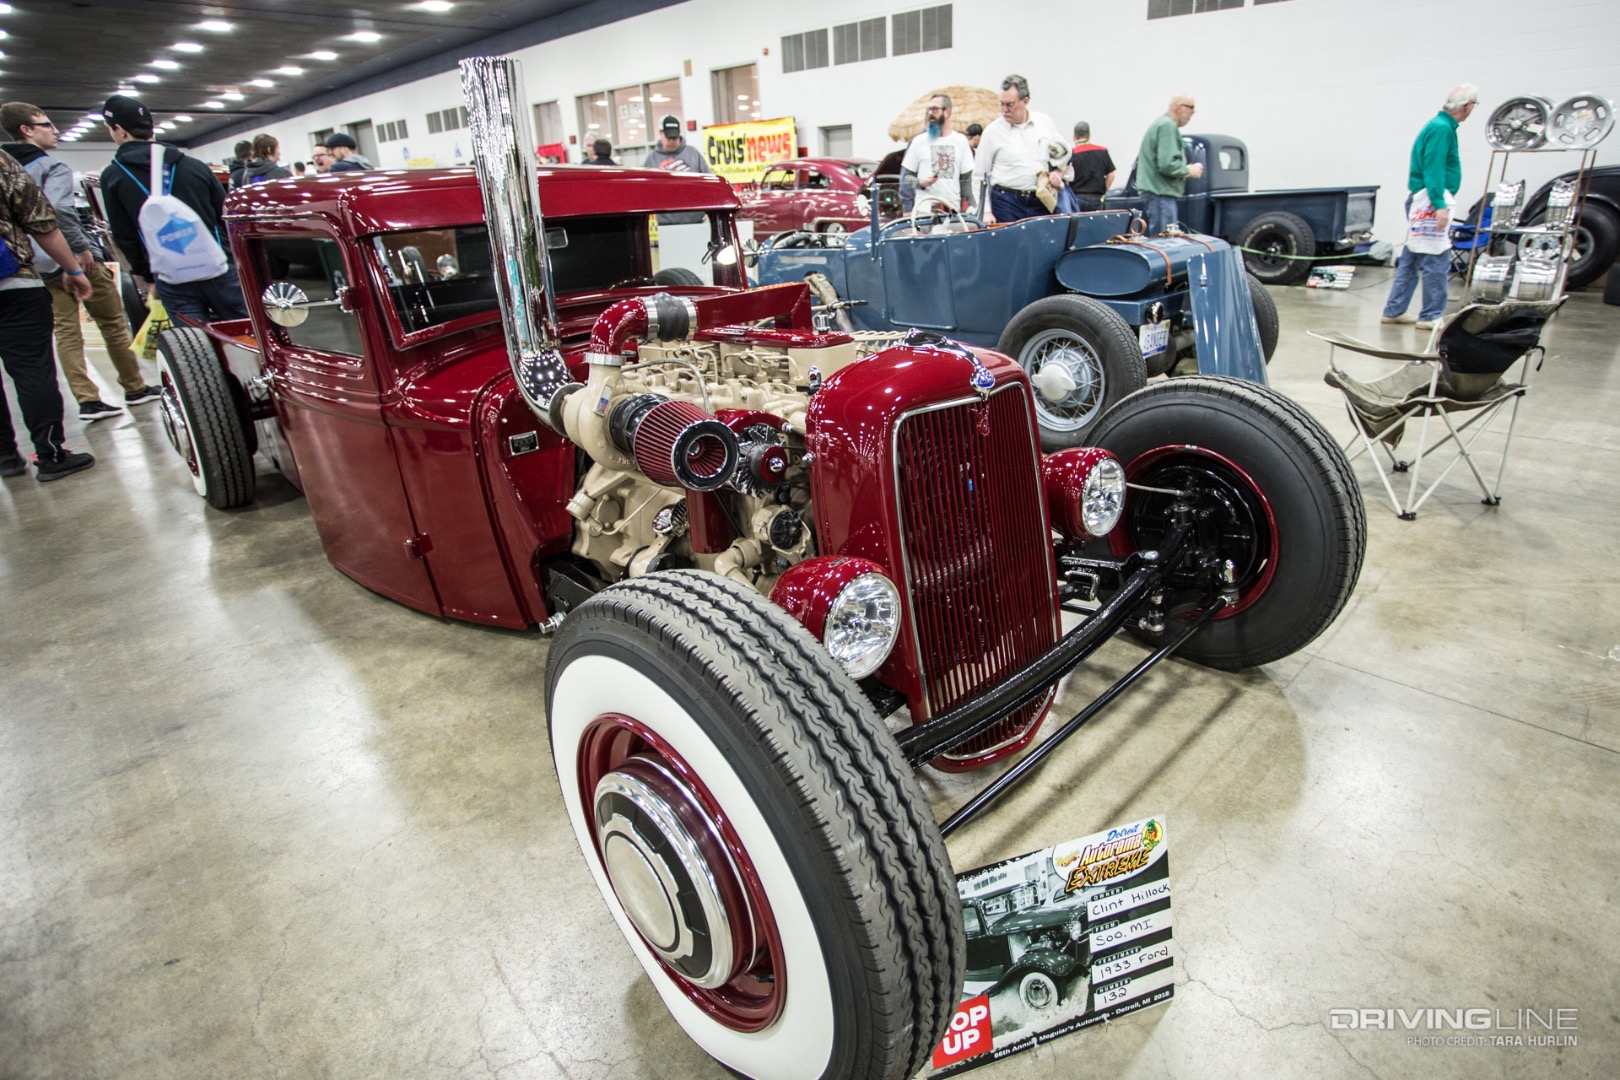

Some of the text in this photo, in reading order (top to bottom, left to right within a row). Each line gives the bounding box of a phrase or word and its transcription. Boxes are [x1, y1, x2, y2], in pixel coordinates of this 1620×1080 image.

[1106, 823, 1140, 842] Detroit
[1078, 833, 1143, 867] Autorama
[1065, 846, 1154, 894] EXTREME
[1092, 883, 1170, 916] Clint Hillock
[1093, 888, 1121, 900] OWNER
[1095, 921, 1115, 933] FROM
[1130, 919, 1153, 934] MI
[1100, 945, 1168, 979] 1933 Ford
[1099, 979, 1129, 993] NUMBER
[1103, 988, 1128, 1004] 132
[945, 1005, 987, 1035] OP
[1012, 1038, 1037, 1053] Annua
[1115, 1001, 1141, 1014] Detroit,
[1142, 998, 1151, 1006] MI
[943, 1028, 980, 1055] UP
